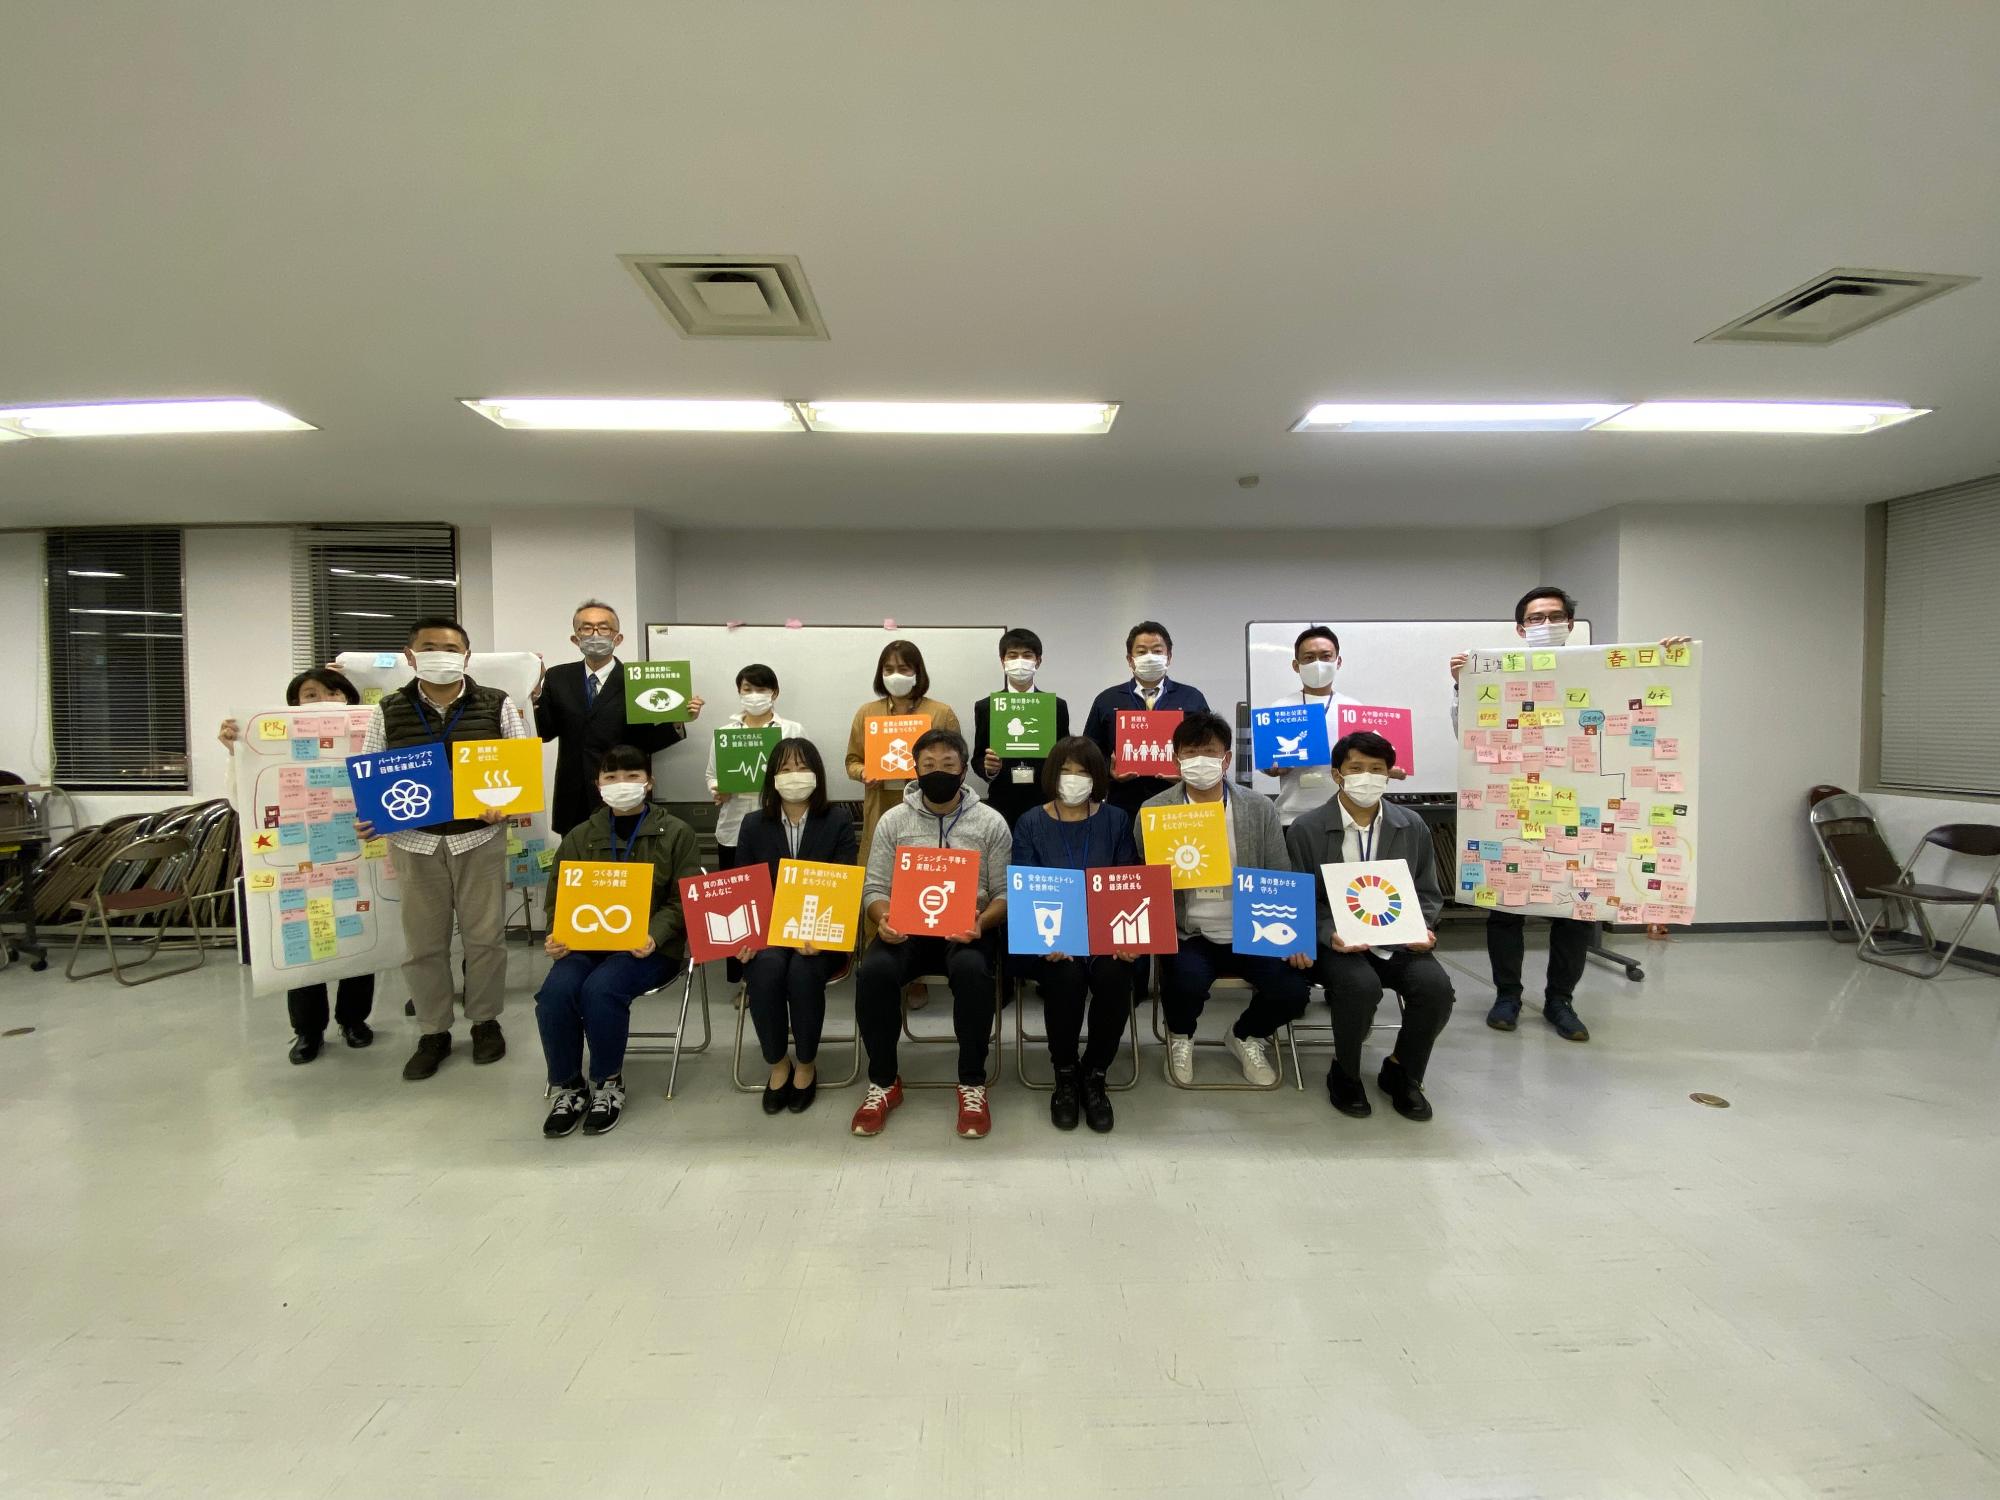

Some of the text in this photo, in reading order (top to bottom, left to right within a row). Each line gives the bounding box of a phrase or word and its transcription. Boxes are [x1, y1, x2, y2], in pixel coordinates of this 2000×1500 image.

[1608, 647, 1684, 667] 春日部
[628, 666, 642, 680] 13
[1479, 687, 1495, 701] 人
[994, 698, 1007, 712] 15
[1256, 712, 1270, 726] 16
[1275, 716, 1308, 724] すべての人に
[1342, 710, 1356, 724] 10
[1361, 711, 1401, 720] 人や国の不平等
[1362, 718, 1388, 726] をなくそう
[870, 722, 878, 734] 9
[1119, 716, 1126, 730] 1
[1130, 722, 1150, 730] なくそう
[719, 734, 728, 748] 3
[378, 750, 433, 765] パートナーシップで
[459, 747, 470, 764] 2
[352, 760, 372, 779] 17
[380, 758, 433, 775] 目標を達成しよう
[1148, 814, 1156, 832] 7
[900, 852, 912, 871] 5
[916, 854, 968, 865] ジェンダー平等を
[592, 869, 629, 878] つくる責任
[916, 864, 948, 872] 実現しよう
[564, 868, 584, 887] 12
[702, 873, 751, 890] 質の高い教育を
[783, 866, 798, 885] 11
[802, 877, 838, 888] まちづくりを
[1013, 872, 1023, 891] 6
[1028, 874, 1075, 884] 安全な水とトイレ
[1108, 873, 1142, 882] 働きがいも
[1260, 876, 1297, 888] 海の豊かさを
[592, 879, 627, 888] つかう責任
[1029, 884, 1060, 893] を世界中に
[1092, 874, 1103, 892] 8
[1108, 882, 1142, 892] 経済成長も
[1237, 874, 1254, 893] 14
[687, 883, 700, 902] 4
[704, 887, 732, 898] みんなに
[1260, 886, 1278, 895] 守ろう
